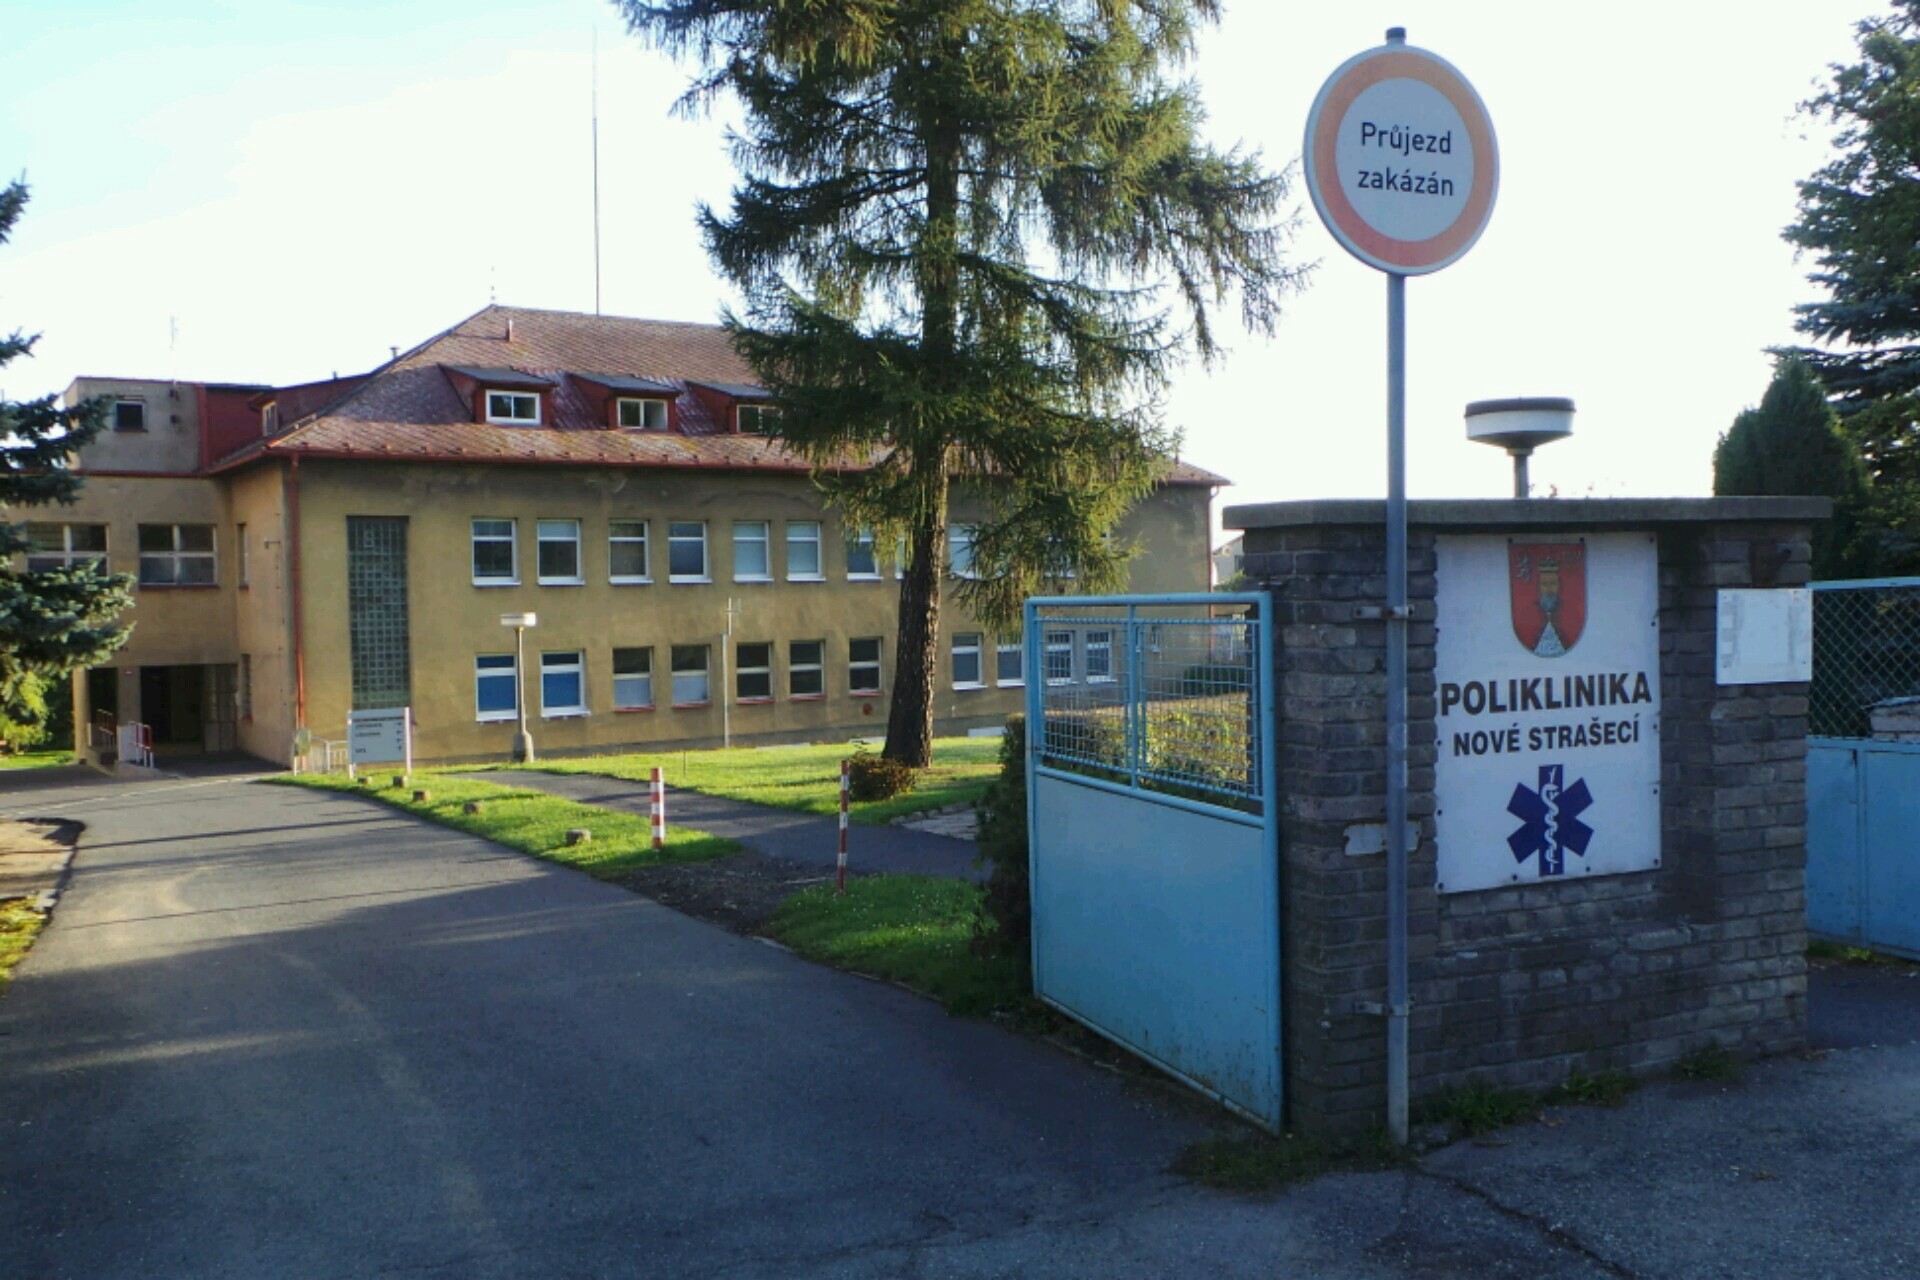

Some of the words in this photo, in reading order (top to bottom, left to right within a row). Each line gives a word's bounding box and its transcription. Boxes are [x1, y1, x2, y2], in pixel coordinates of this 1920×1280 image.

[1361, 121, 1452, 156] Průjezd
[1357, 166, 1454, 196] zakázán
[1440, 672, 1652, 716] POLIKLINIKA
[1453, 722, 1521, 757] NOVÉ
[1528, 713, 1640, 751] STRAŠECÍ
